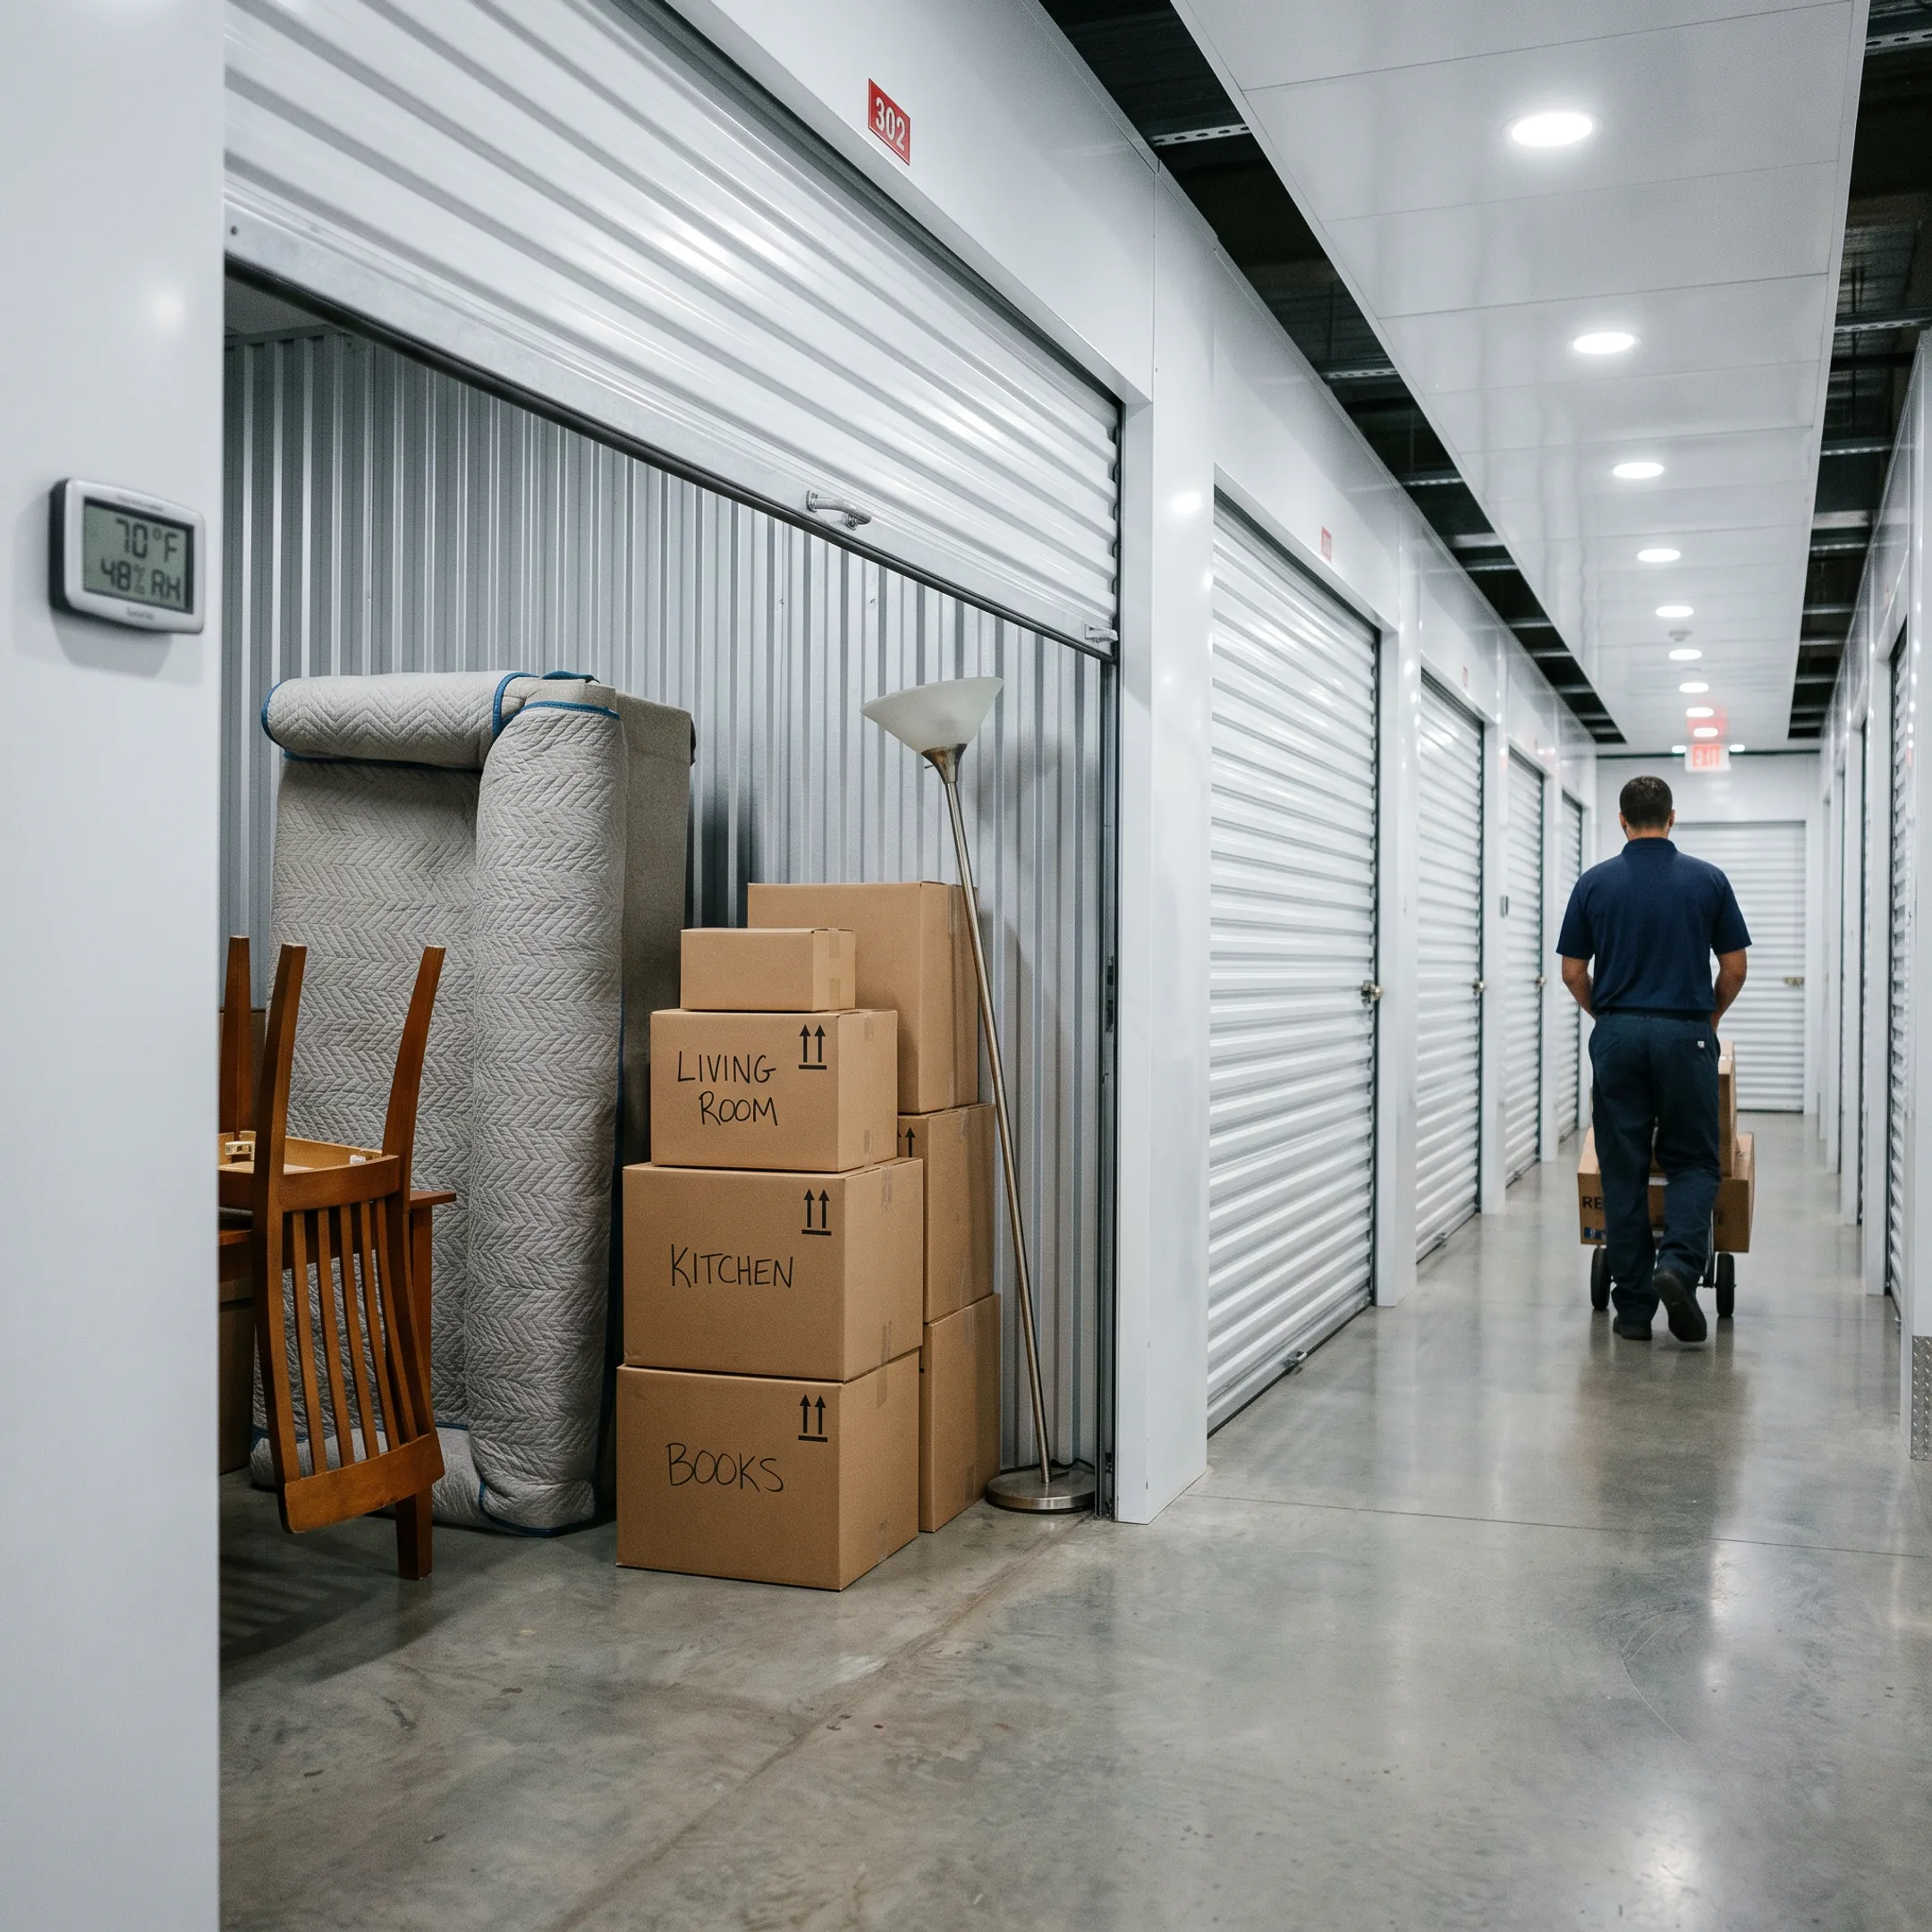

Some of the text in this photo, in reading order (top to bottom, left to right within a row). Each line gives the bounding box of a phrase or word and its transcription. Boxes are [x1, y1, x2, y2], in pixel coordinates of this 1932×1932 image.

[876, 97, 905, 151] 302
[150, 569, 181, 601] RH
[1691, 744, 1722, 767] EXIT
[677, 1050, 776, 1083] LIVING
[699, 1090, 778, 1126] ROOM
[671, 1244, 793, 1288] KITCHEN
[665, 1442, 784, 1493] BOOKS
